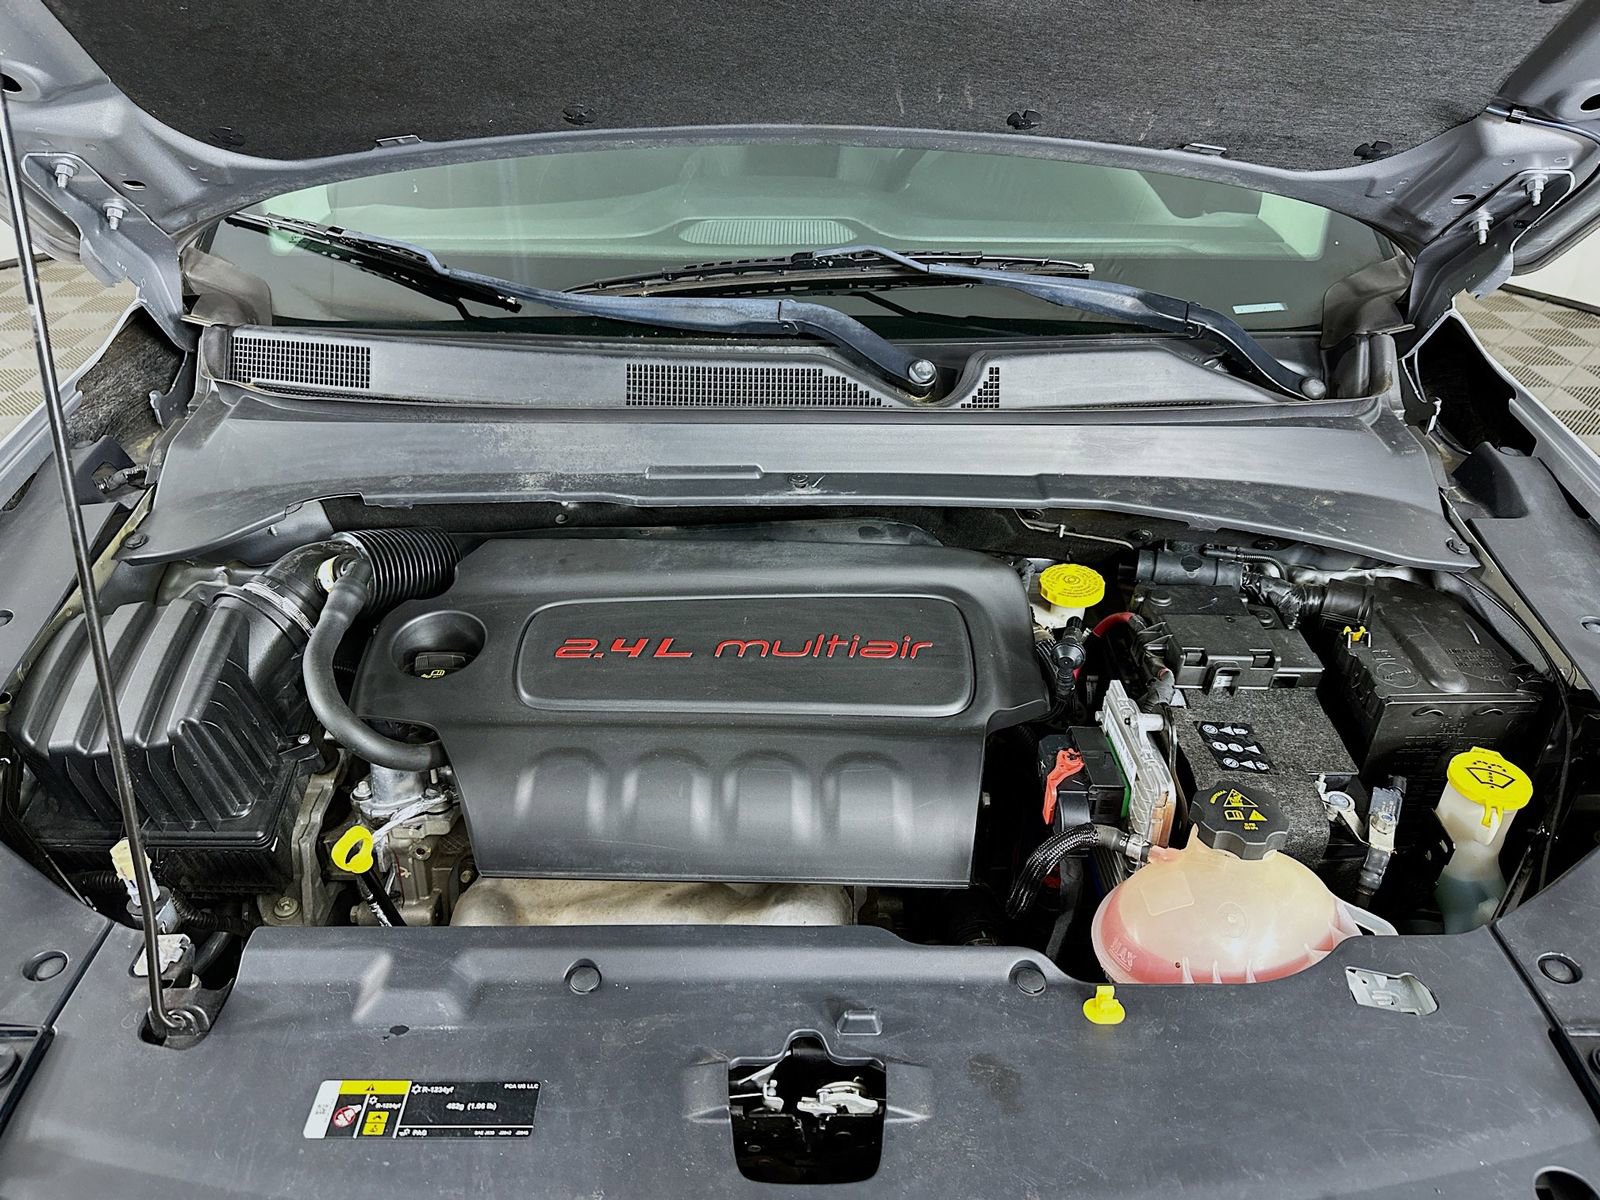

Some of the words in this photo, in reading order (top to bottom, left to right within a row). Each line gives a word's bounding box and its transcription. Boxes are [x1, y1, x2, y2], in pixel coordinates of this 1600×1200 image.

[554, 637, 693, 659] 2.4L
[713, 633, 934, 659] multiair
[1109, 936, 1137, 967] MAX
